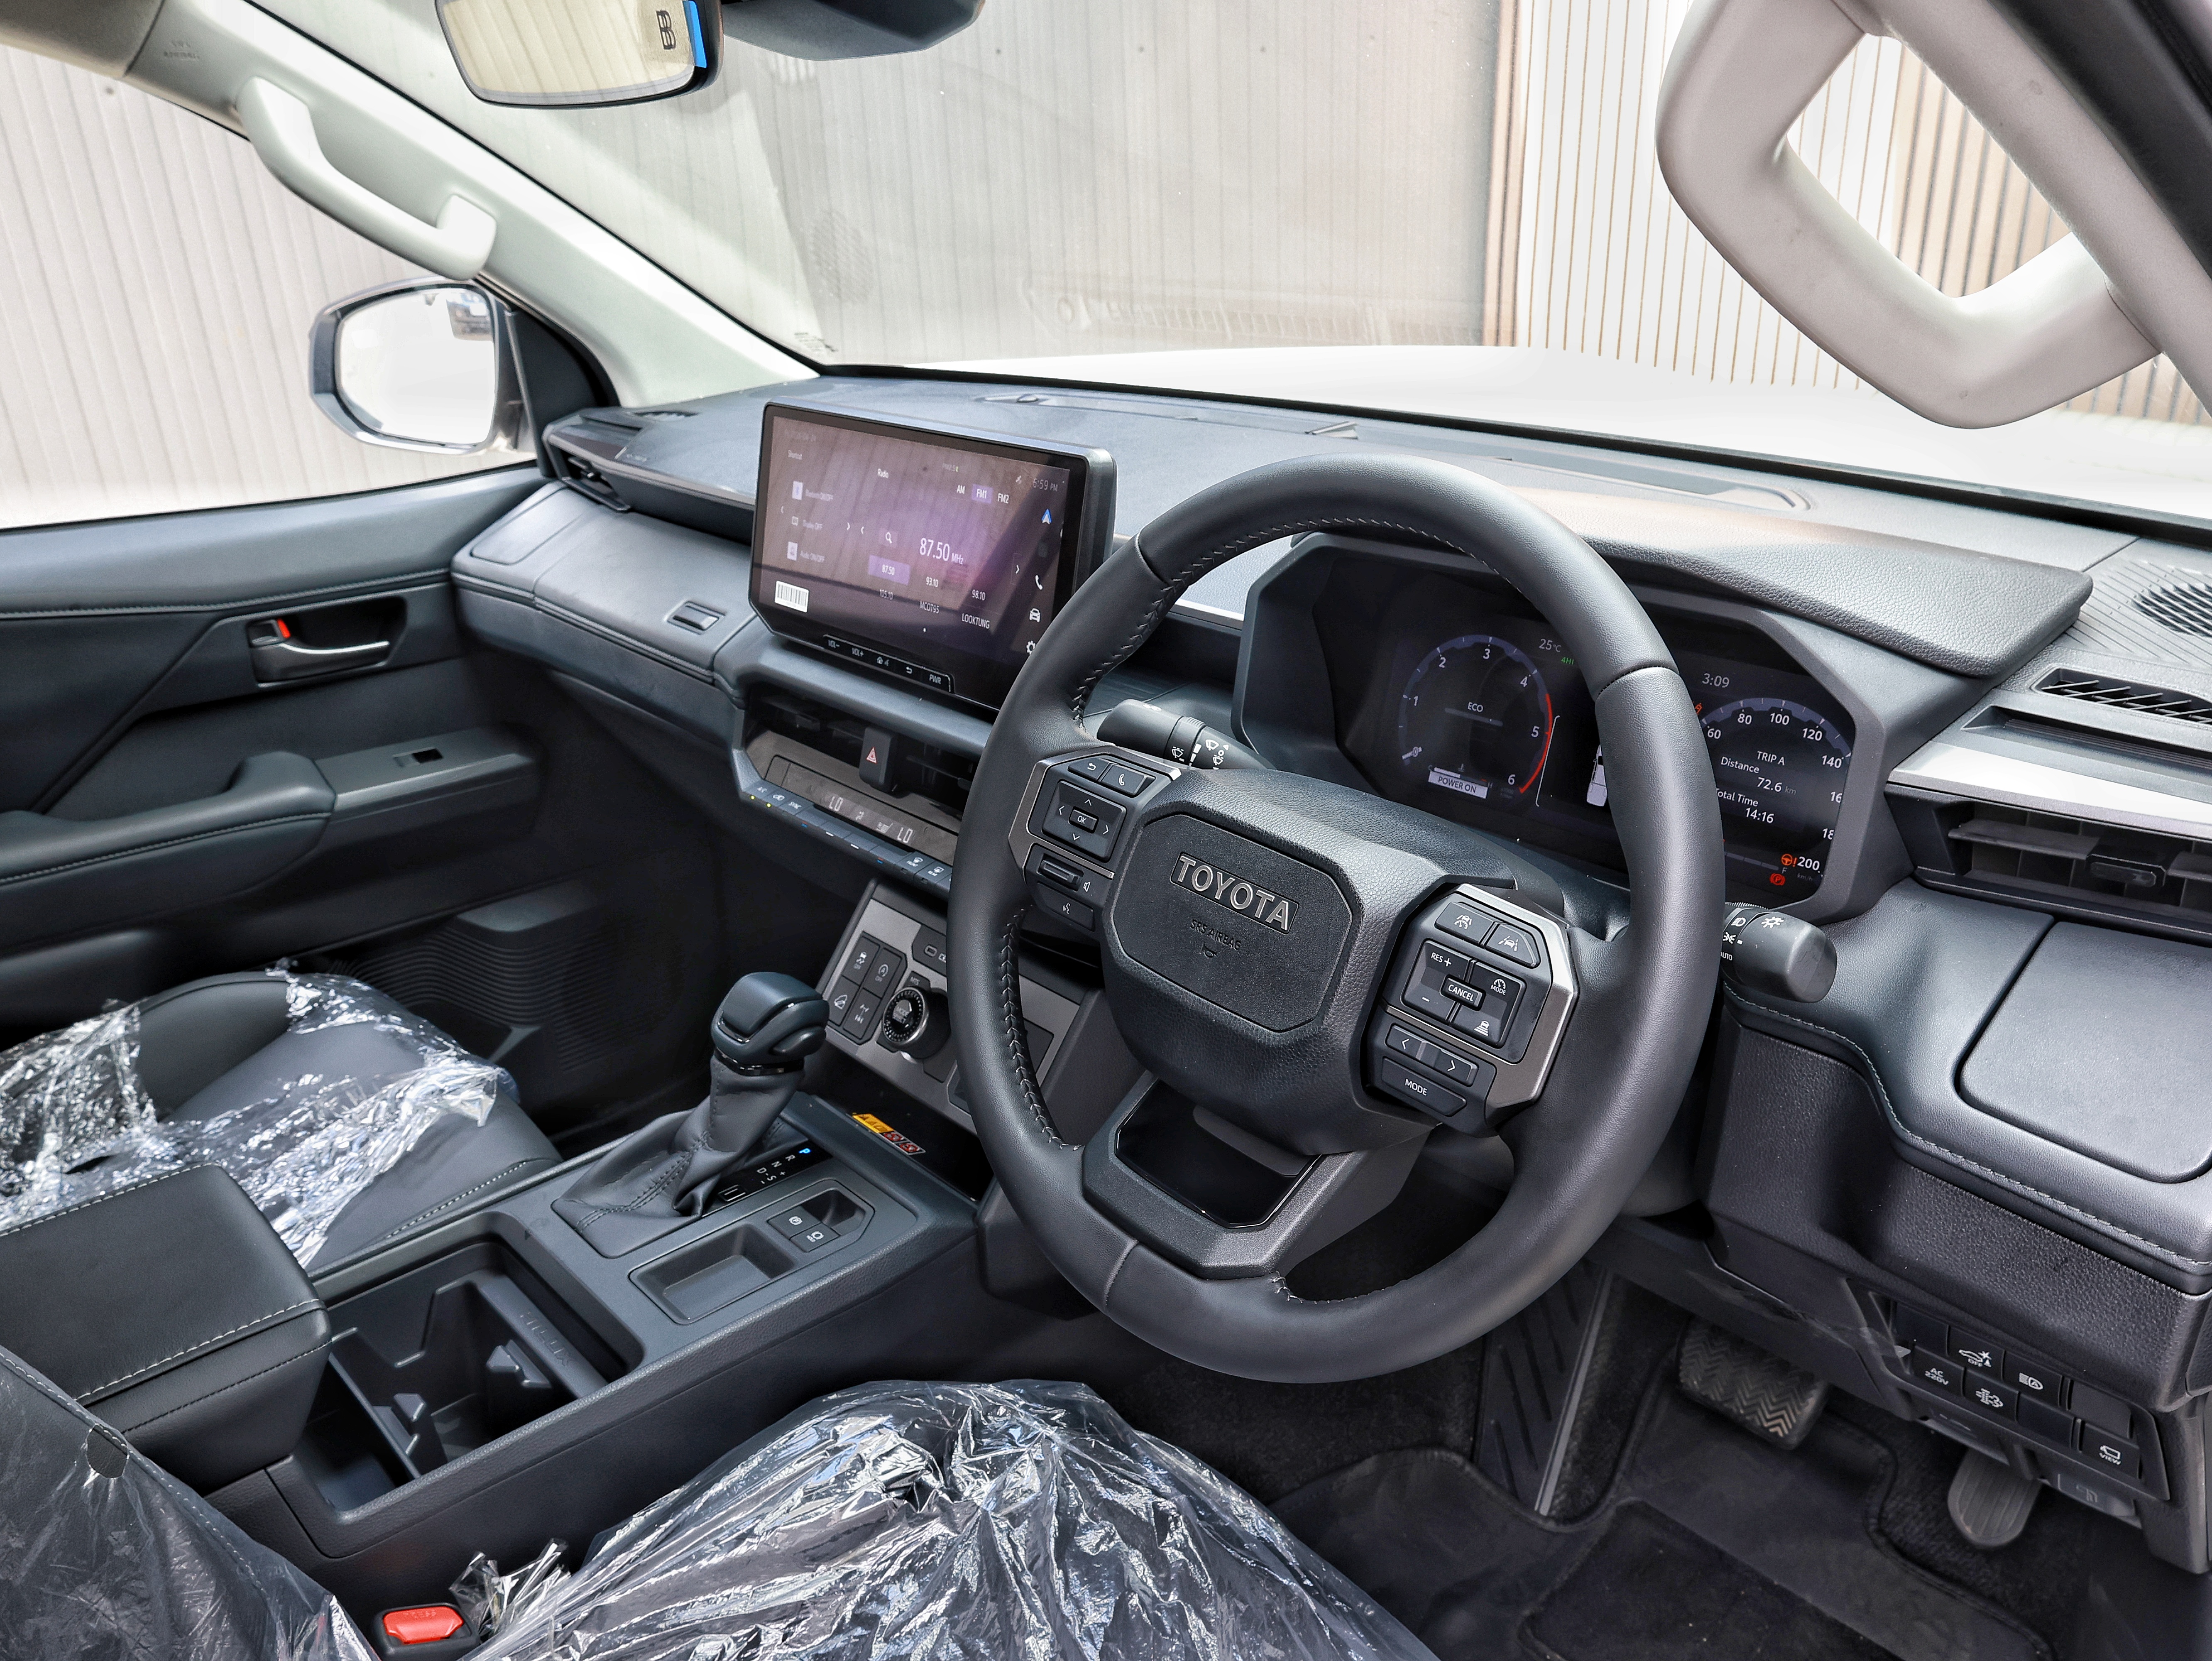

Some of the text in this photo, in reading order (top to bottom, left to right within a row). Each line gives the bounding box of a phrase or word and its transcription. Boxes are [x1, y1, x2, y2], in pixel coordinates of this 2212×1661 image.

[878, 468, 889, 478] Radio
[957, 485, 965, 494] AM
[1033, 478, 1058, 492] 6:59 PM
[976, 488, 987, 499] FM1
[998, 493, 1009, 504] FM2
[920, 538, 964, 565] 87.50 MHz
[882, 565, 895, 575] 87.50
[926, 576, 939, 588] 93.10
[972, 589, 986, 601] 98.10
[920, 600, 940, 614] MCOT95
[962, 613, 990, 629] LOOKTUNG
[1483, 648, 1490, 659] 3
[1439, 657, 1446, 668] 2
[929, 674, 941, 684] PWR
[1520, 676, 1527, 687] 4
[1702, 673, 1730, 688] 3:09
[1413, 696, 1419, 706] 1
[1467, 702, 1483, 713] ECO
[1737, 713, 1752, 725] 80
[1769, 713, 1790, 725] 100
[1531, 726, 1539, 738] 5
[1708, 728, 1721, 739] 60
[1802, 728, 1823, 742] 120
[1757, 750, 1785, 765] TRIP A
[1822, 755, 1842, 768] 140
[1721, 756, 1759, 774] Distance
[1438, 776, 1477, 794] POWER ON
[1508, 774, 1516, 785] 6
[1757, 777, 1796, 795] 72.6 km
[1737, 794, 1759, 807] Time
[1830, 791, 1842, 803] 16
[1077, 815, 1086, 824] OK
[1745, 807, 1774, 823] 14:16
[1823, 828, 1834, 840] 18
[1797, 856, 1820, 871] 200
[1174, 855, 1290, 931] TOYOTA
[1190, 919, 1241, 951] SRS AIRBAG
[1431, 952, 1444, 963] RES
[1448, 984, 1474, 1002] CANCEL
[1490, 984, 1507, 995] MODE
[1405, 1078, 1428, 1096] MODE
[1924, 1370, 1949, 1385] 220V
[1931, 1367, 1944, 1378] AC
[2099, 1452, 2121, 1465] VIEW
